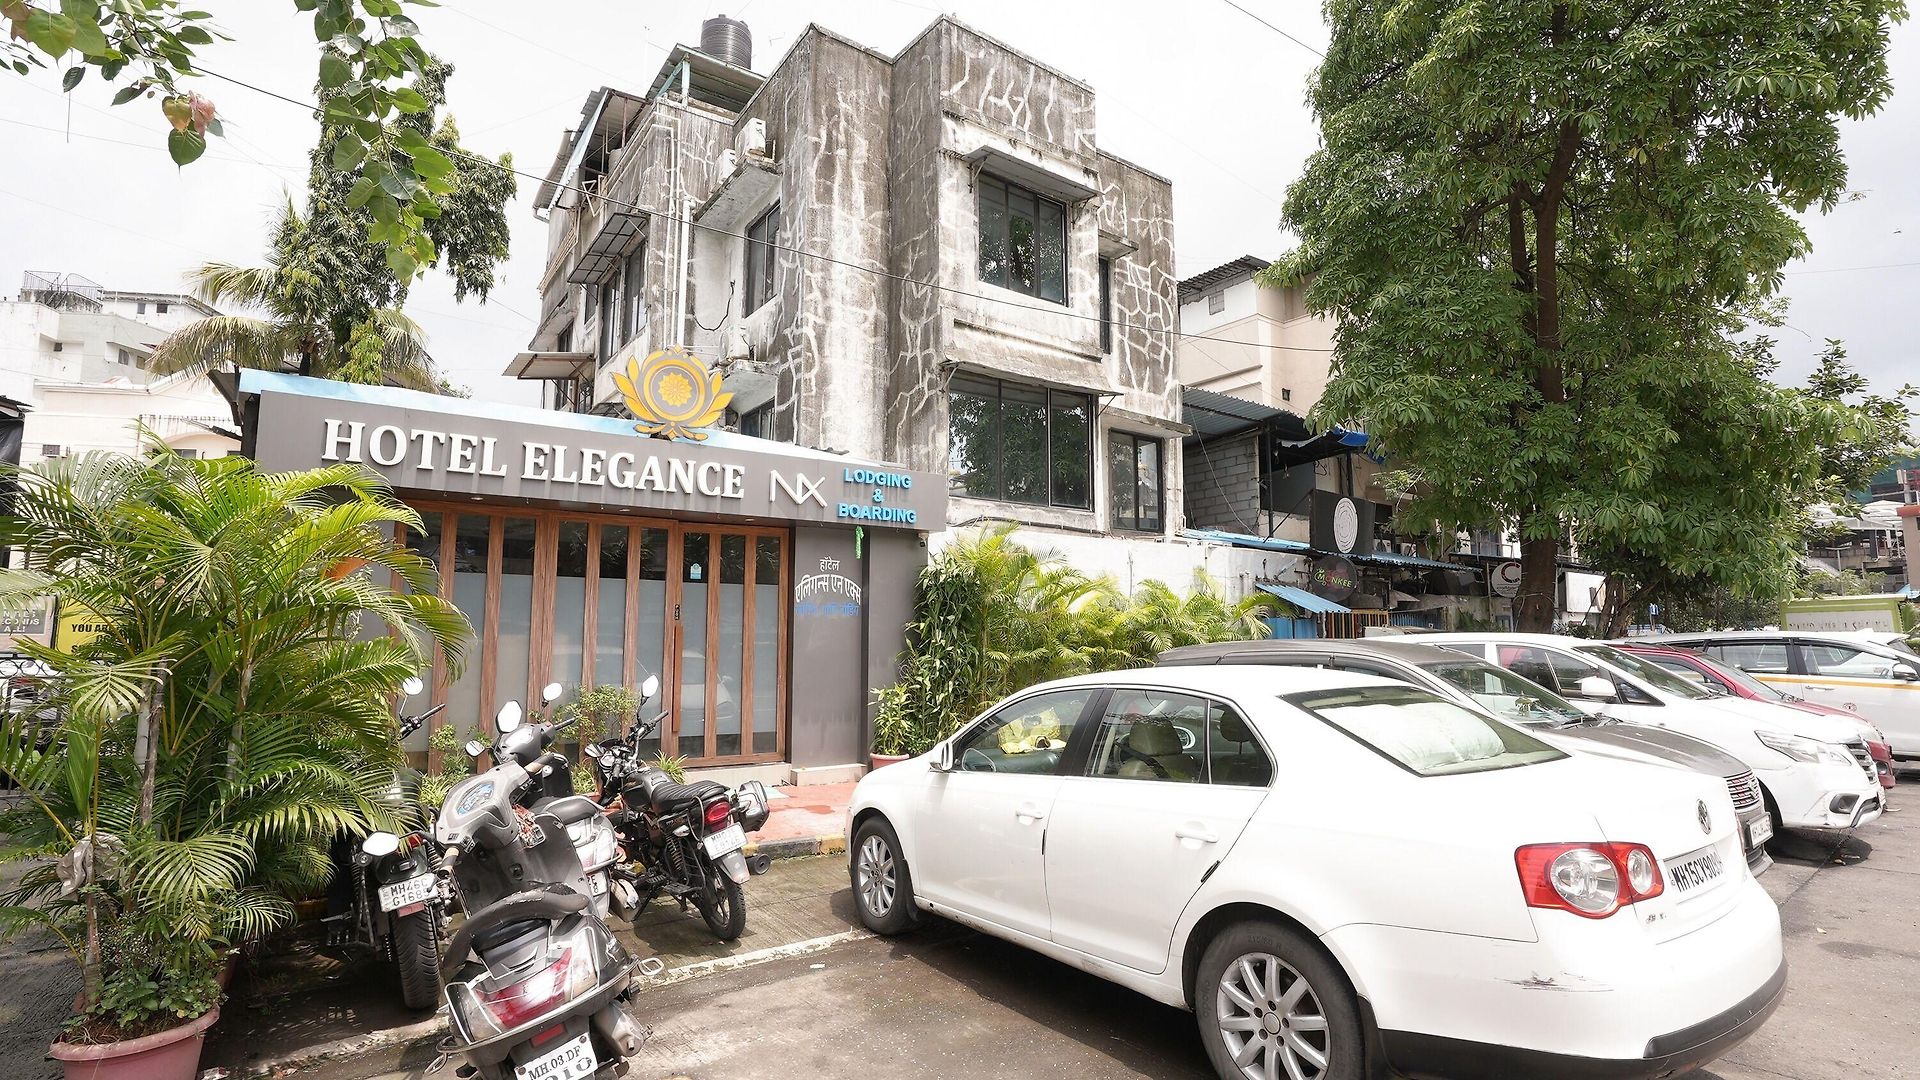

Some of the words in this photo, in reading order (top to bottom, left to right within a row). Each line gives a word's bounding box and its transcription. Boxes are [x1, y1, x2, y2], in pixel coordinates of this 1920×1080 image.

[321, 419, 507, 477] HOTEL
[520, 441, 745, 499] ELEGANCE
[769, 469, 828, 508] NX
[843, 467, 912, 489] LODGING
[872, 488, 885, 503] &
[837, 502, 917, 524] BOARDING
[820, 556, 840, 571] हॉटेल
[830, 574, 844, 594] एन
[71, 624, 92, 632] YOU
[94, 624, 111, 632] AR
[528, 1045, 581, 1080] MH.03.DF
